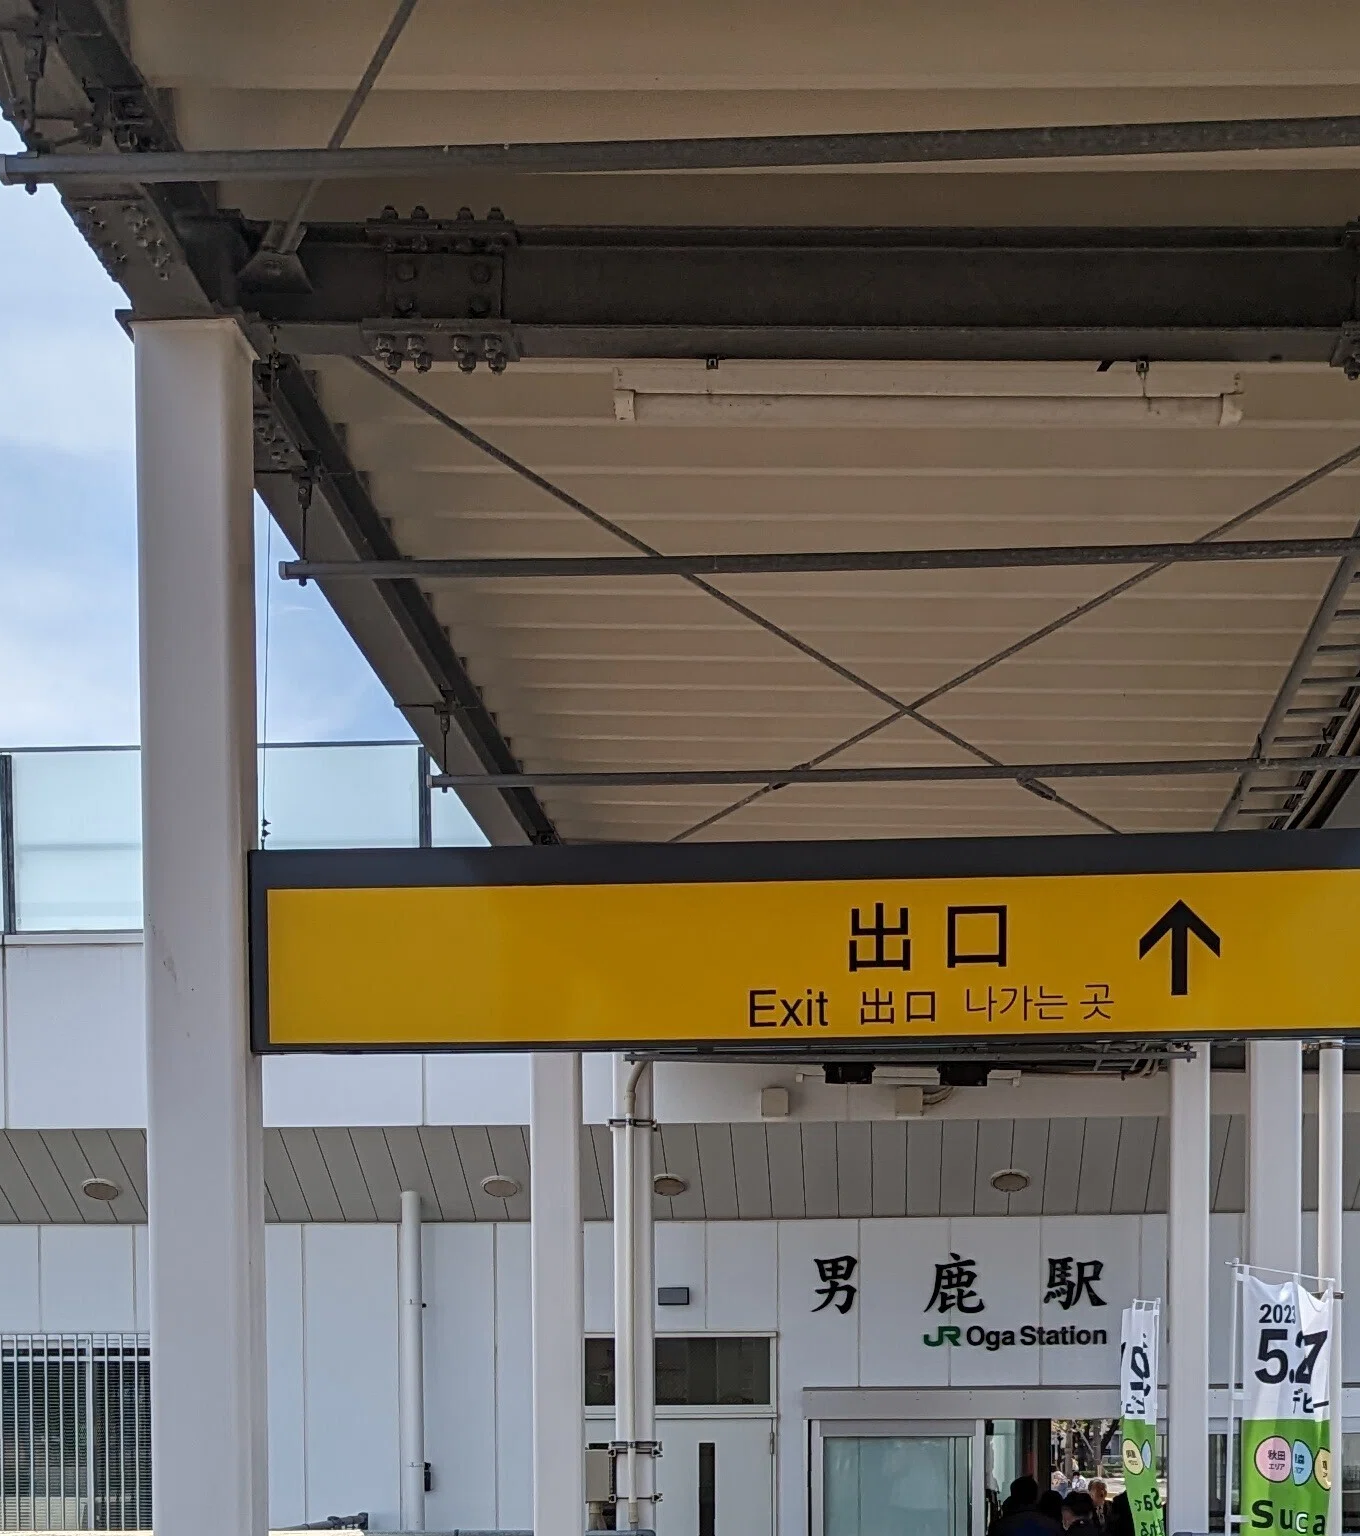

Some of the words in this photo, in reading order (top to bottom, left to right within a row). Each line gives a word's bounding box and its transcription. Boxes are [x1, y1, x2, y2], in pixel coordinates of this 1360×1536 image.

[848, 902, 1009, 973] 出口
[749, 988, 829, 1028] Exit
[860, 987, 937, 1026] 出口
[965, 984, 1068, 1023] 나가는
[1079, 984, 1115, 1021] 곳
[811, 1253, 1108, 1315] 男鹿駅
[923, 1325, 961, 1347] JR
[966, 1325, 1016, 1352] Oga
[1019, 1325, 1108, 1346] Station
[1267, 1449, 1286, 1461] 秋田
